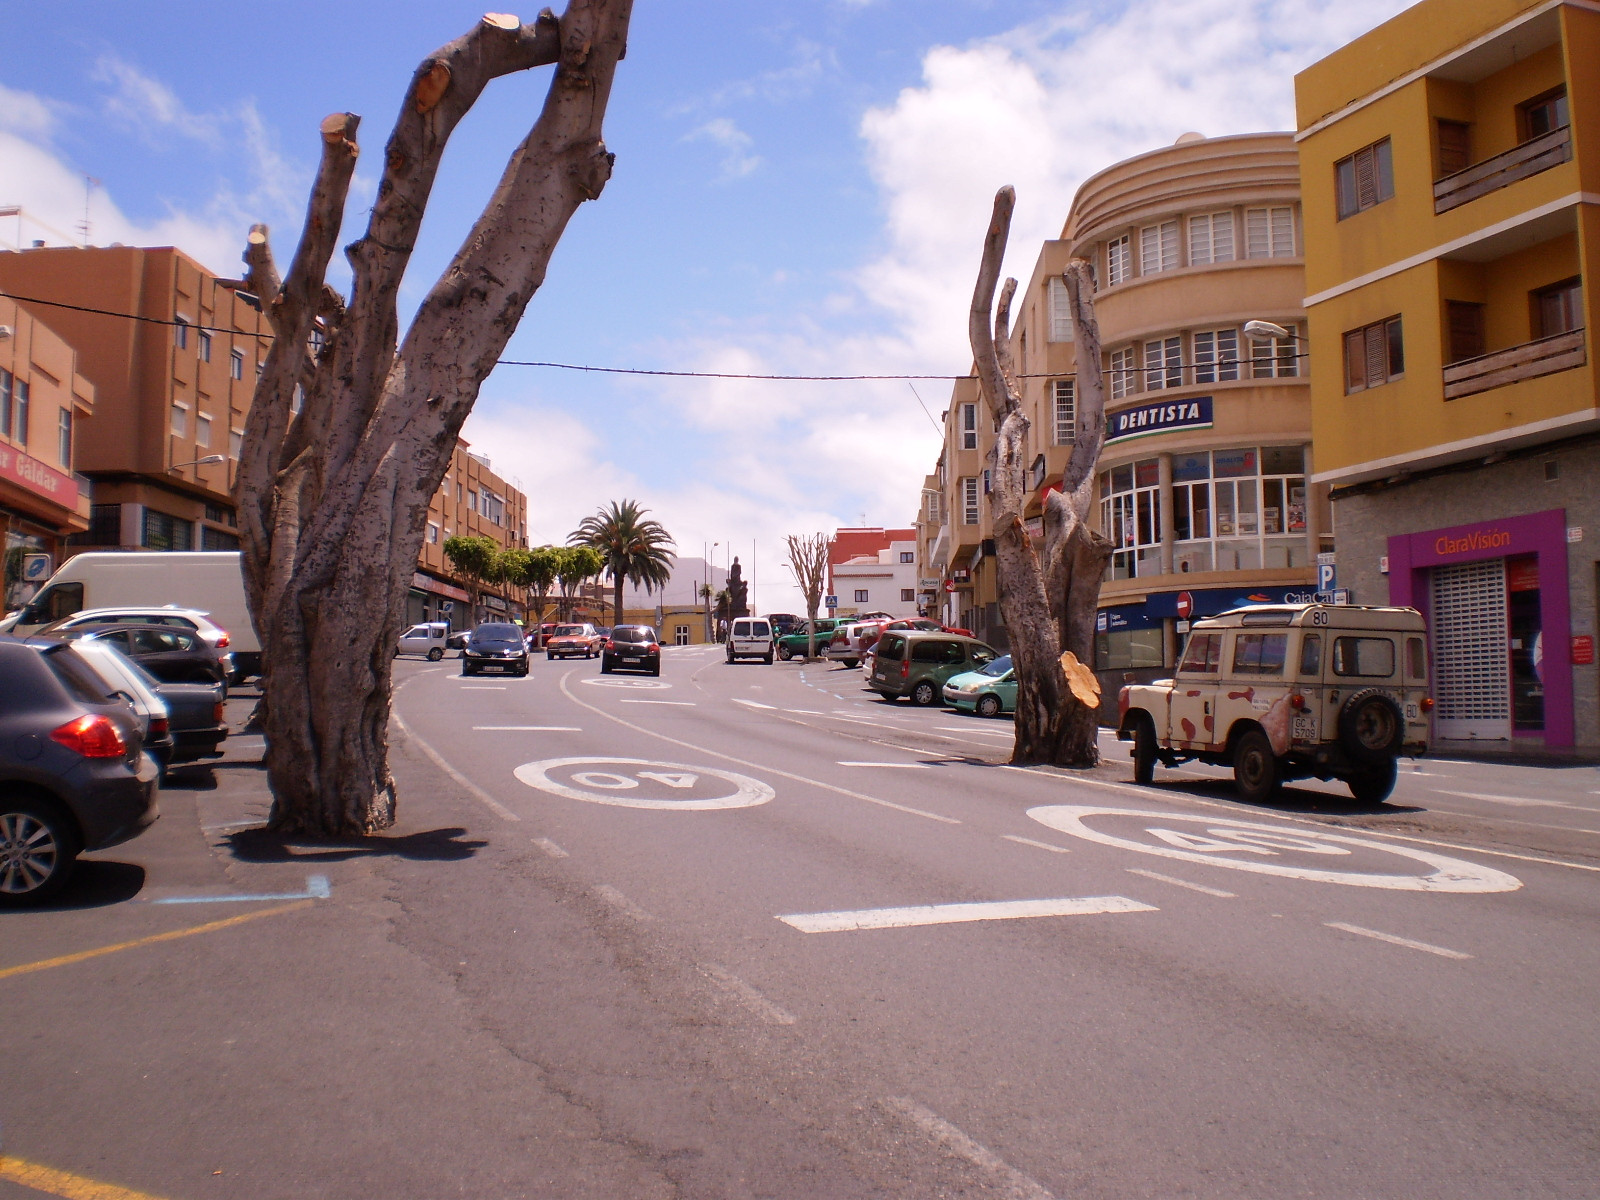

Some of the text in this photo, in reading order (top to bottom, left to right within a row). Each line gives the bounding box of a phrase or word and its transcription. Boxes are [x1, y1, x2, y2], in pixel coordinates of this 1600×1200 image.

[1119, 402, 1200, 430] DENTISTA
[1435, 528, 1511, 555] ClaraVisión
[1321, 565, 1334, 590] P
[1313, 611, 1328, 625] 80
[1295, 718, 1306, 728] GC
[1294, 728, 1316, 738] 5709
